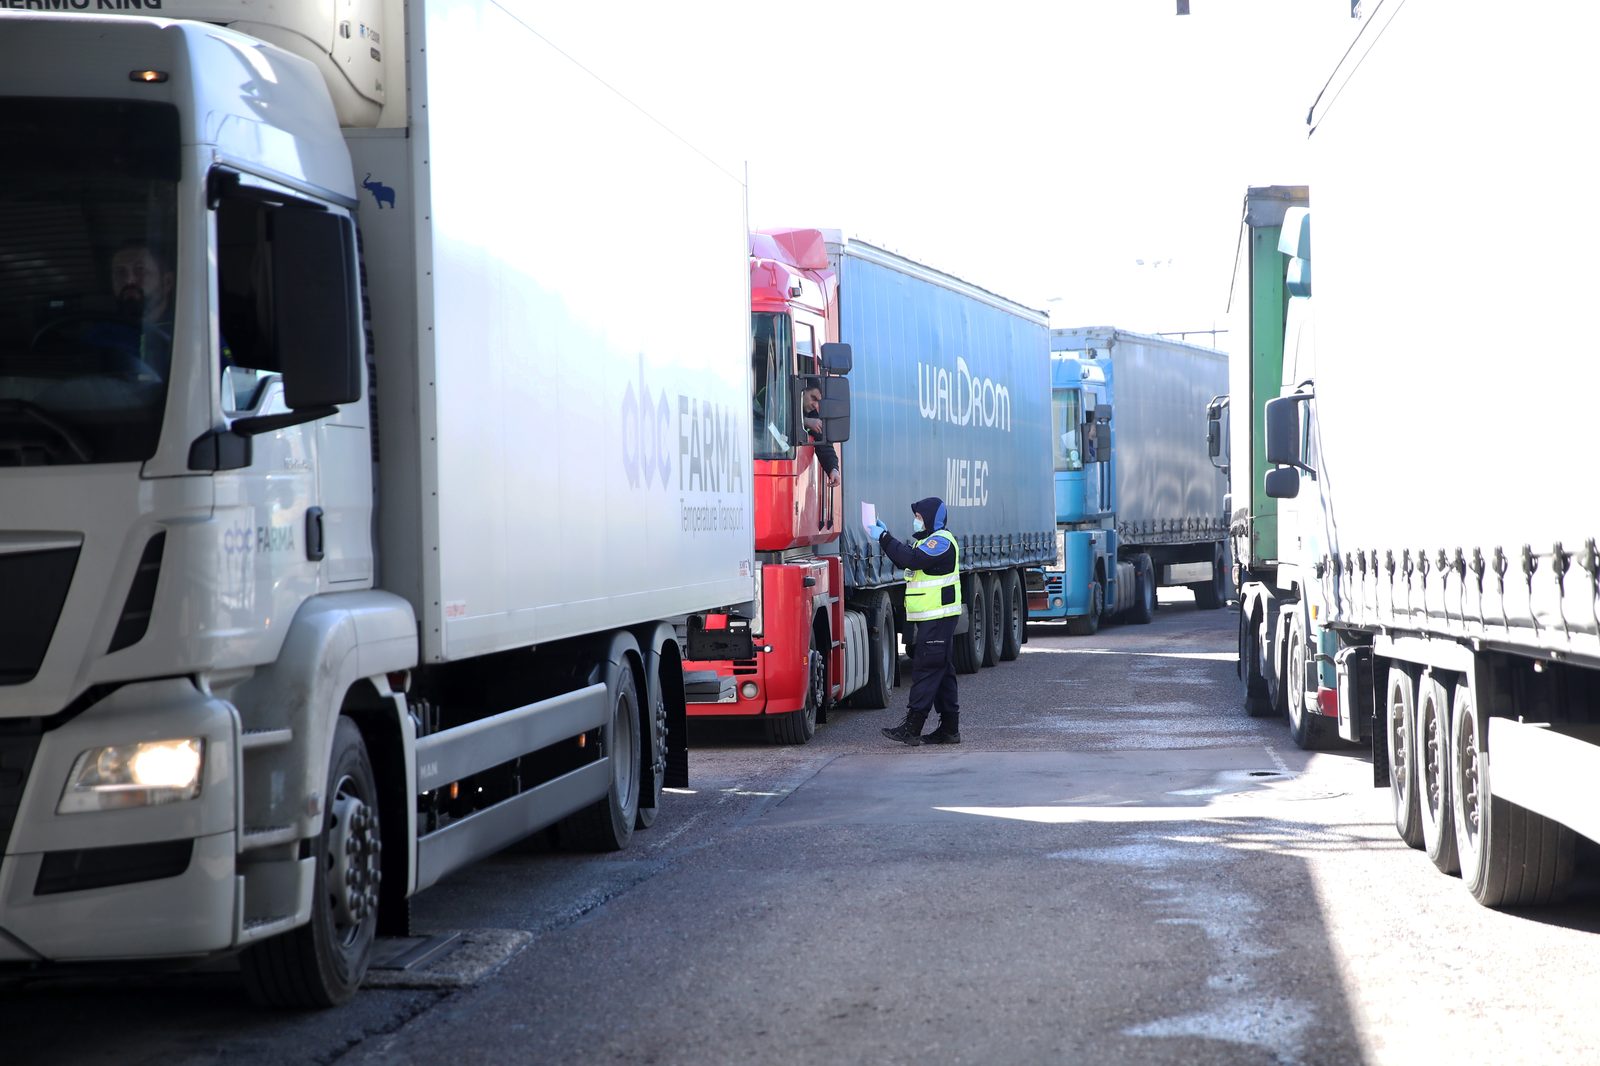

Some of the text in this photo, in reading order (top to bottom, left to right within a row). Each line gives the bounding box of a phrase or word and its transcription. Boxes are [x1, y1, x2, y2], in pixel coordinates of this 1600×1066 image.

[678, 394, 743, 493] FARMA
[945, 457, 989, 507] MIELEC
[680, 498, 744, 538] Temperature Transport
[257, 526, 295, 553] FARMA
[418, 760, 438, 779] MAN
